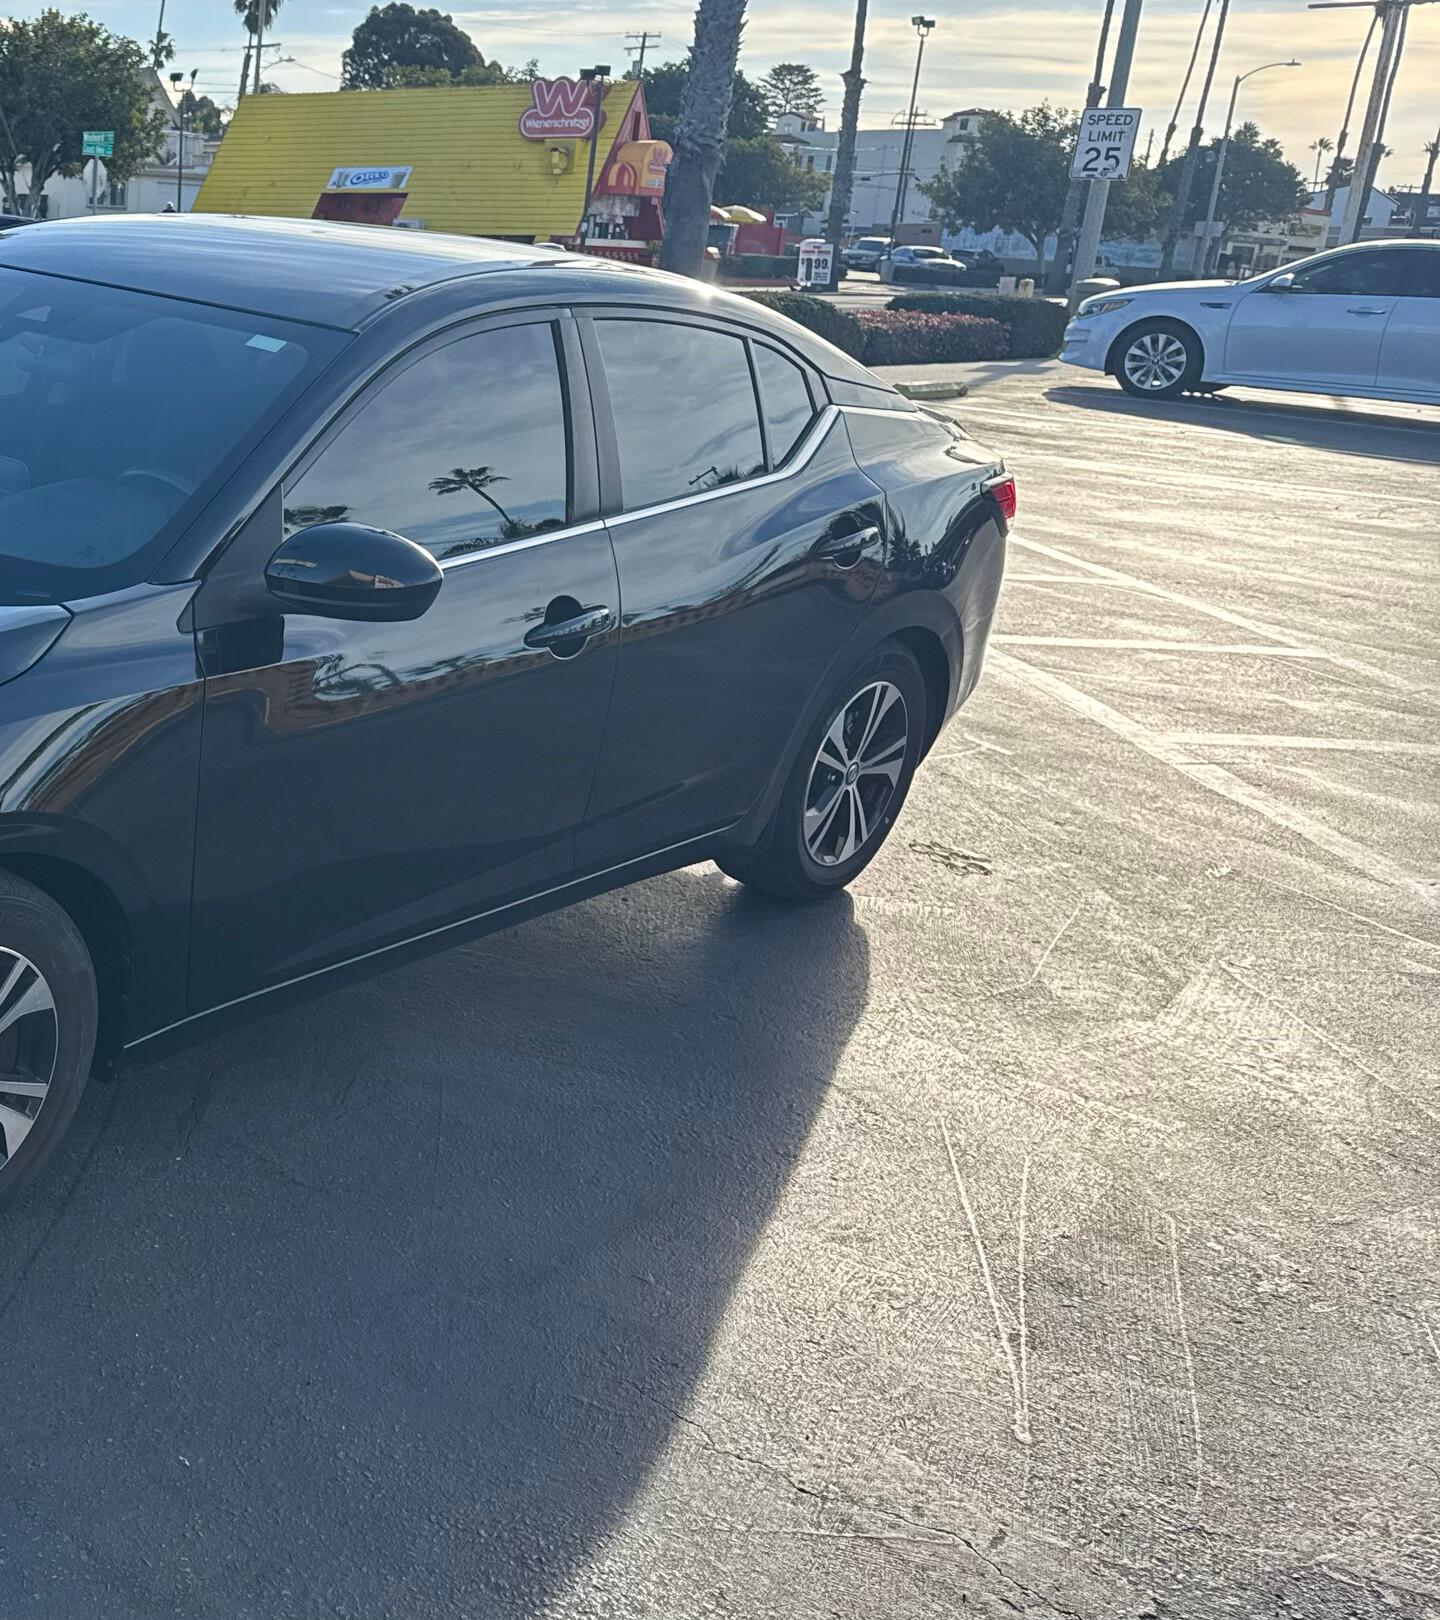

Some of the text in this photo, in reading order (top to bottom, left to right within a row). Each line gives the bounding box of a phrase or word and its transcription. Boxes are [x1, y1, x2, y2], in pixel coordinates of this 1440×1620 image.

[1087, 114, 1133, 126] SPEED
[1088, 130, 1126, 142] LIMIT
[1082, 147, 1121, 172] 25
[350, 170, 389, 185] OREO
